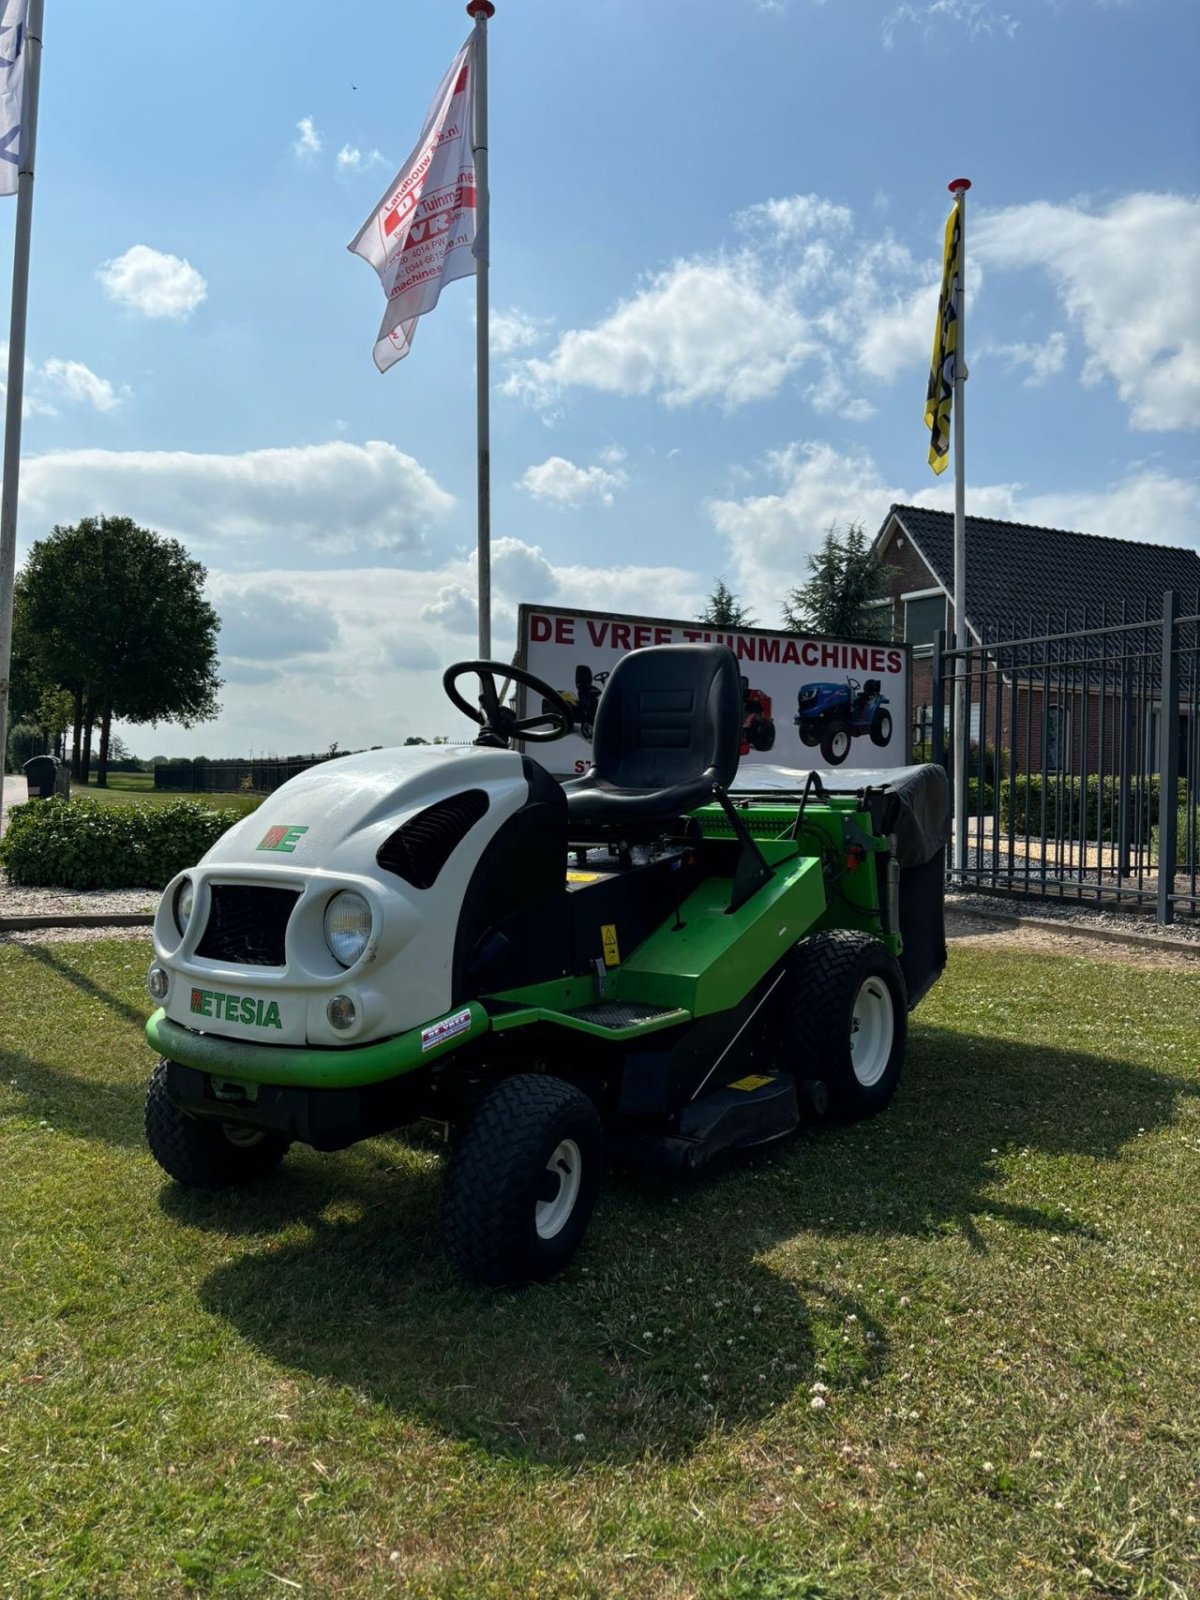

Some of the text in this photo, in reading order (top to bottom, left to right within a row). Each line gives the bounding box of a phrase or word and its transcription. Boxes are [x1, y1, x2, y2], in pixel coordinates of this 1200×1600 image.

[384, 155, 431, 212] Landbouw
[530, 615, 575, 645] DE
[586, 620, 672, 651] VREE
[191, 987, 282, 1029] ETESIA
